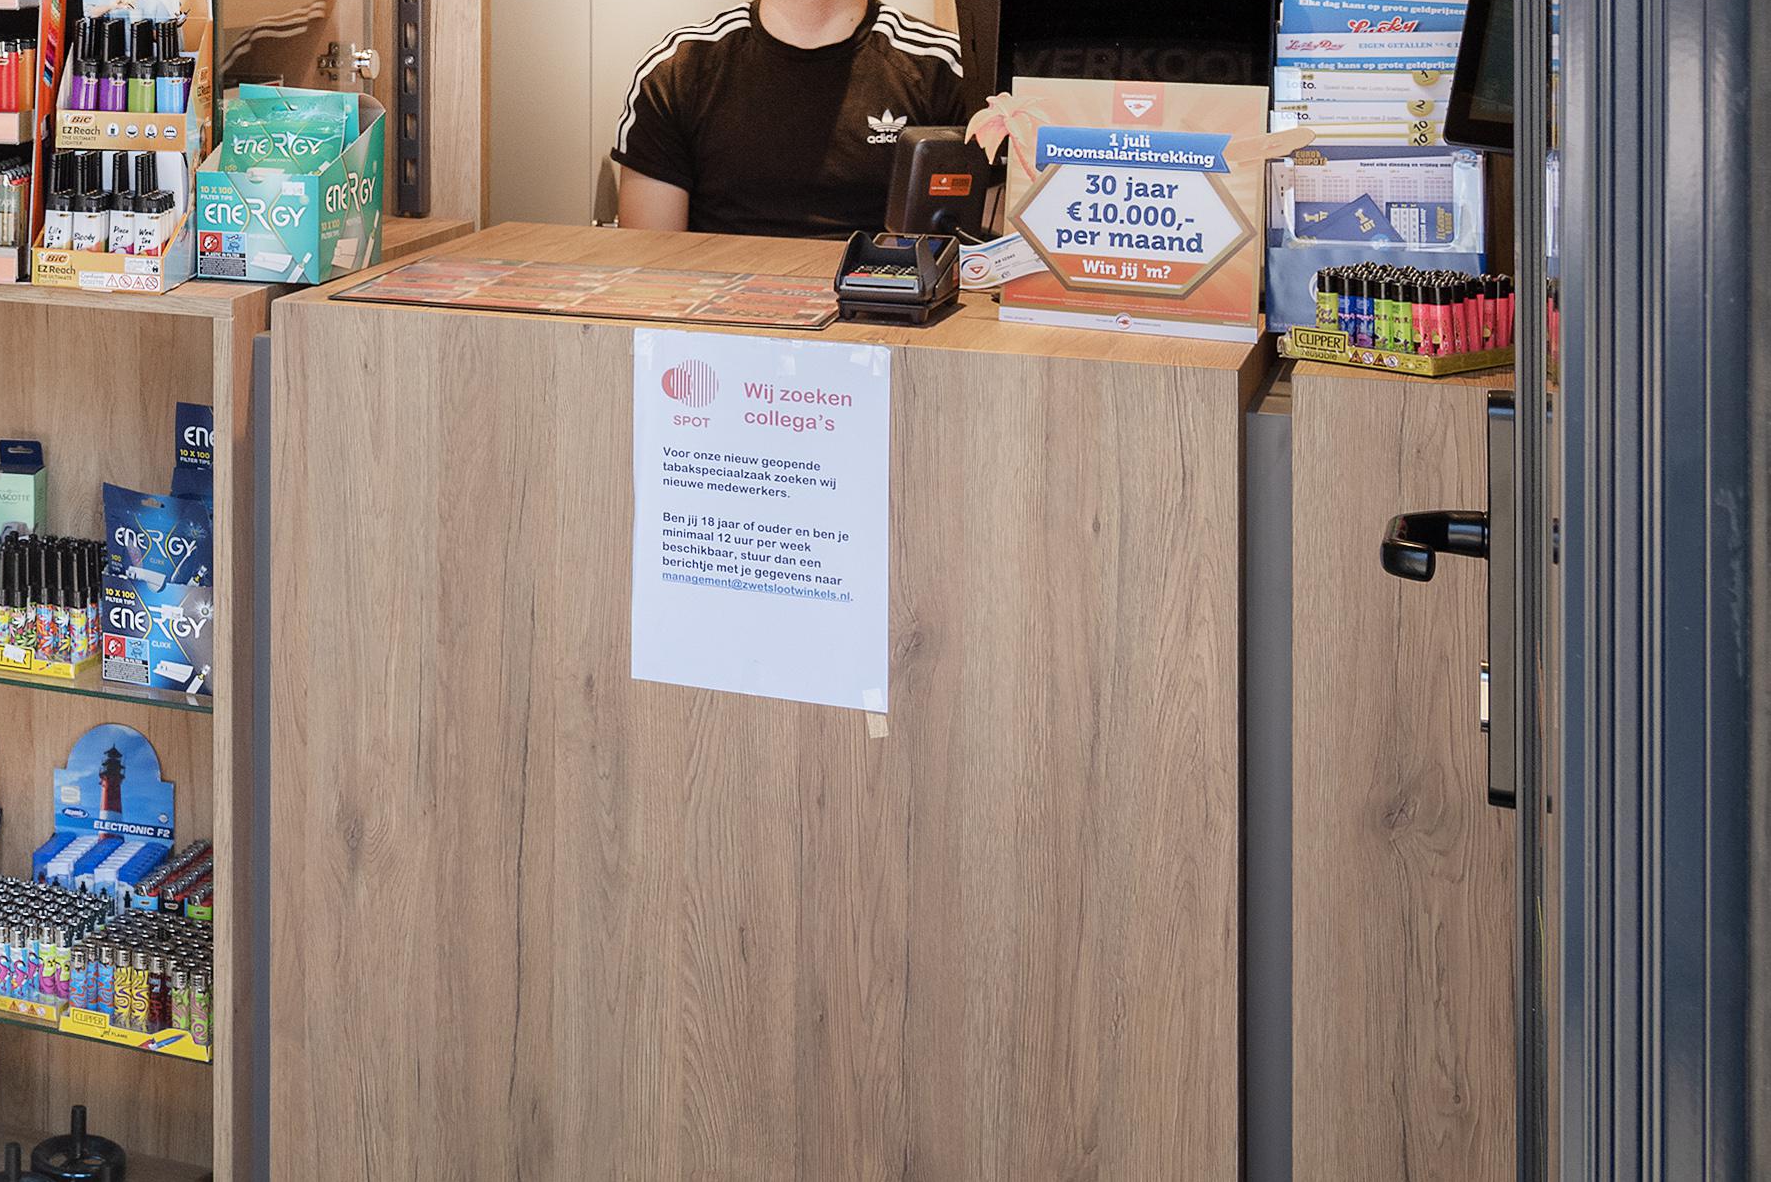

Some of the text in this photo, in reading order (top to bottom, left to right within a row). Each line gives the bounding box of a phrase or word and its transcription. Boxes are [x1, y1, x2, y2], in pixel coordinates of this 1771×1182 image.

[1109, 133, 1150, 150] 1 juli
[1046, 144, 1215, 167] Droomsalaristrekking
[1085, 175, 1178, 201] 30 jaar
[205, 198, 307, 232] ENERGY
[1067, 201, 1194, 231] € 10.000,-
[1056, 227, 1203, 253] per maand
[1082, 259, 1116, 275] Win
[1120, 263, 1137, 279] jij
[1299, 333, 1342, 350] CLIPPER
[744, 382, 852, 407] Wij zoeken
[673, 416, 710, 428] SPOT
[745, 411, 835, 432] collega's
[663, 447, 820, 471] Voor onze nieuw geopende
[663, 463, 836, 490] tabakspeciaalzaak zoeken wij
[663, 478, 790, 498] nieuwe medewerkers.
[663, 512, 849, 542] Ben jij 18 jaar of ouder en ben je
[663, 528, 811, 552] minimaal 12 uur per week
[663, 542, 821, 568] beschikbaar, stuur dan een
[663, 556, 842, 585] berichtje met je gegevens naar
[94, 820, 170, 837] ELECTRONIC F2
